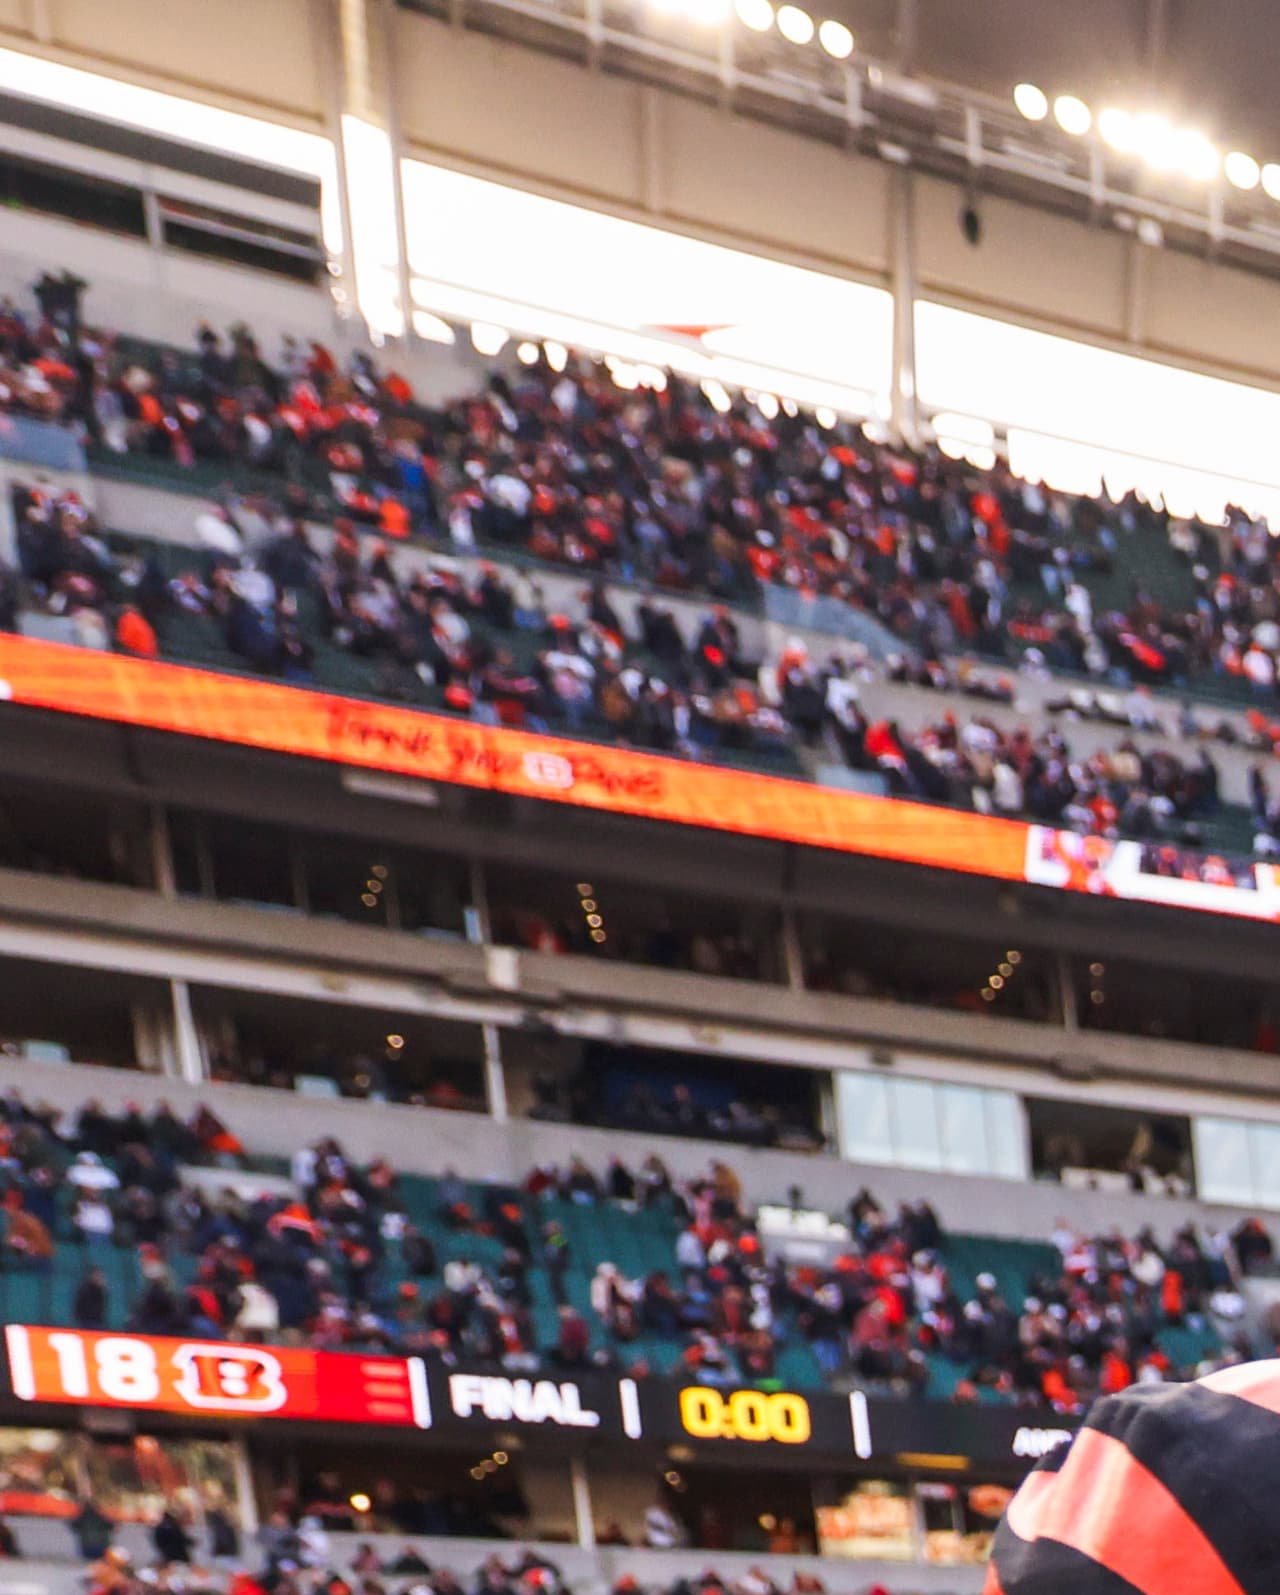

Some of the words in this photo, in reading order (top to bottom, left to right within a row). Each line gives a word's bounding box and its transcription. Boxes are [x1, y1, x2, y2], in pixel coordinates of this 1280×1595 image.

[50, 1333, 158, 1401] 18
[449, 1373, 599, 1428] FINAL
[680, 1386, 811, 1444] 0:00
